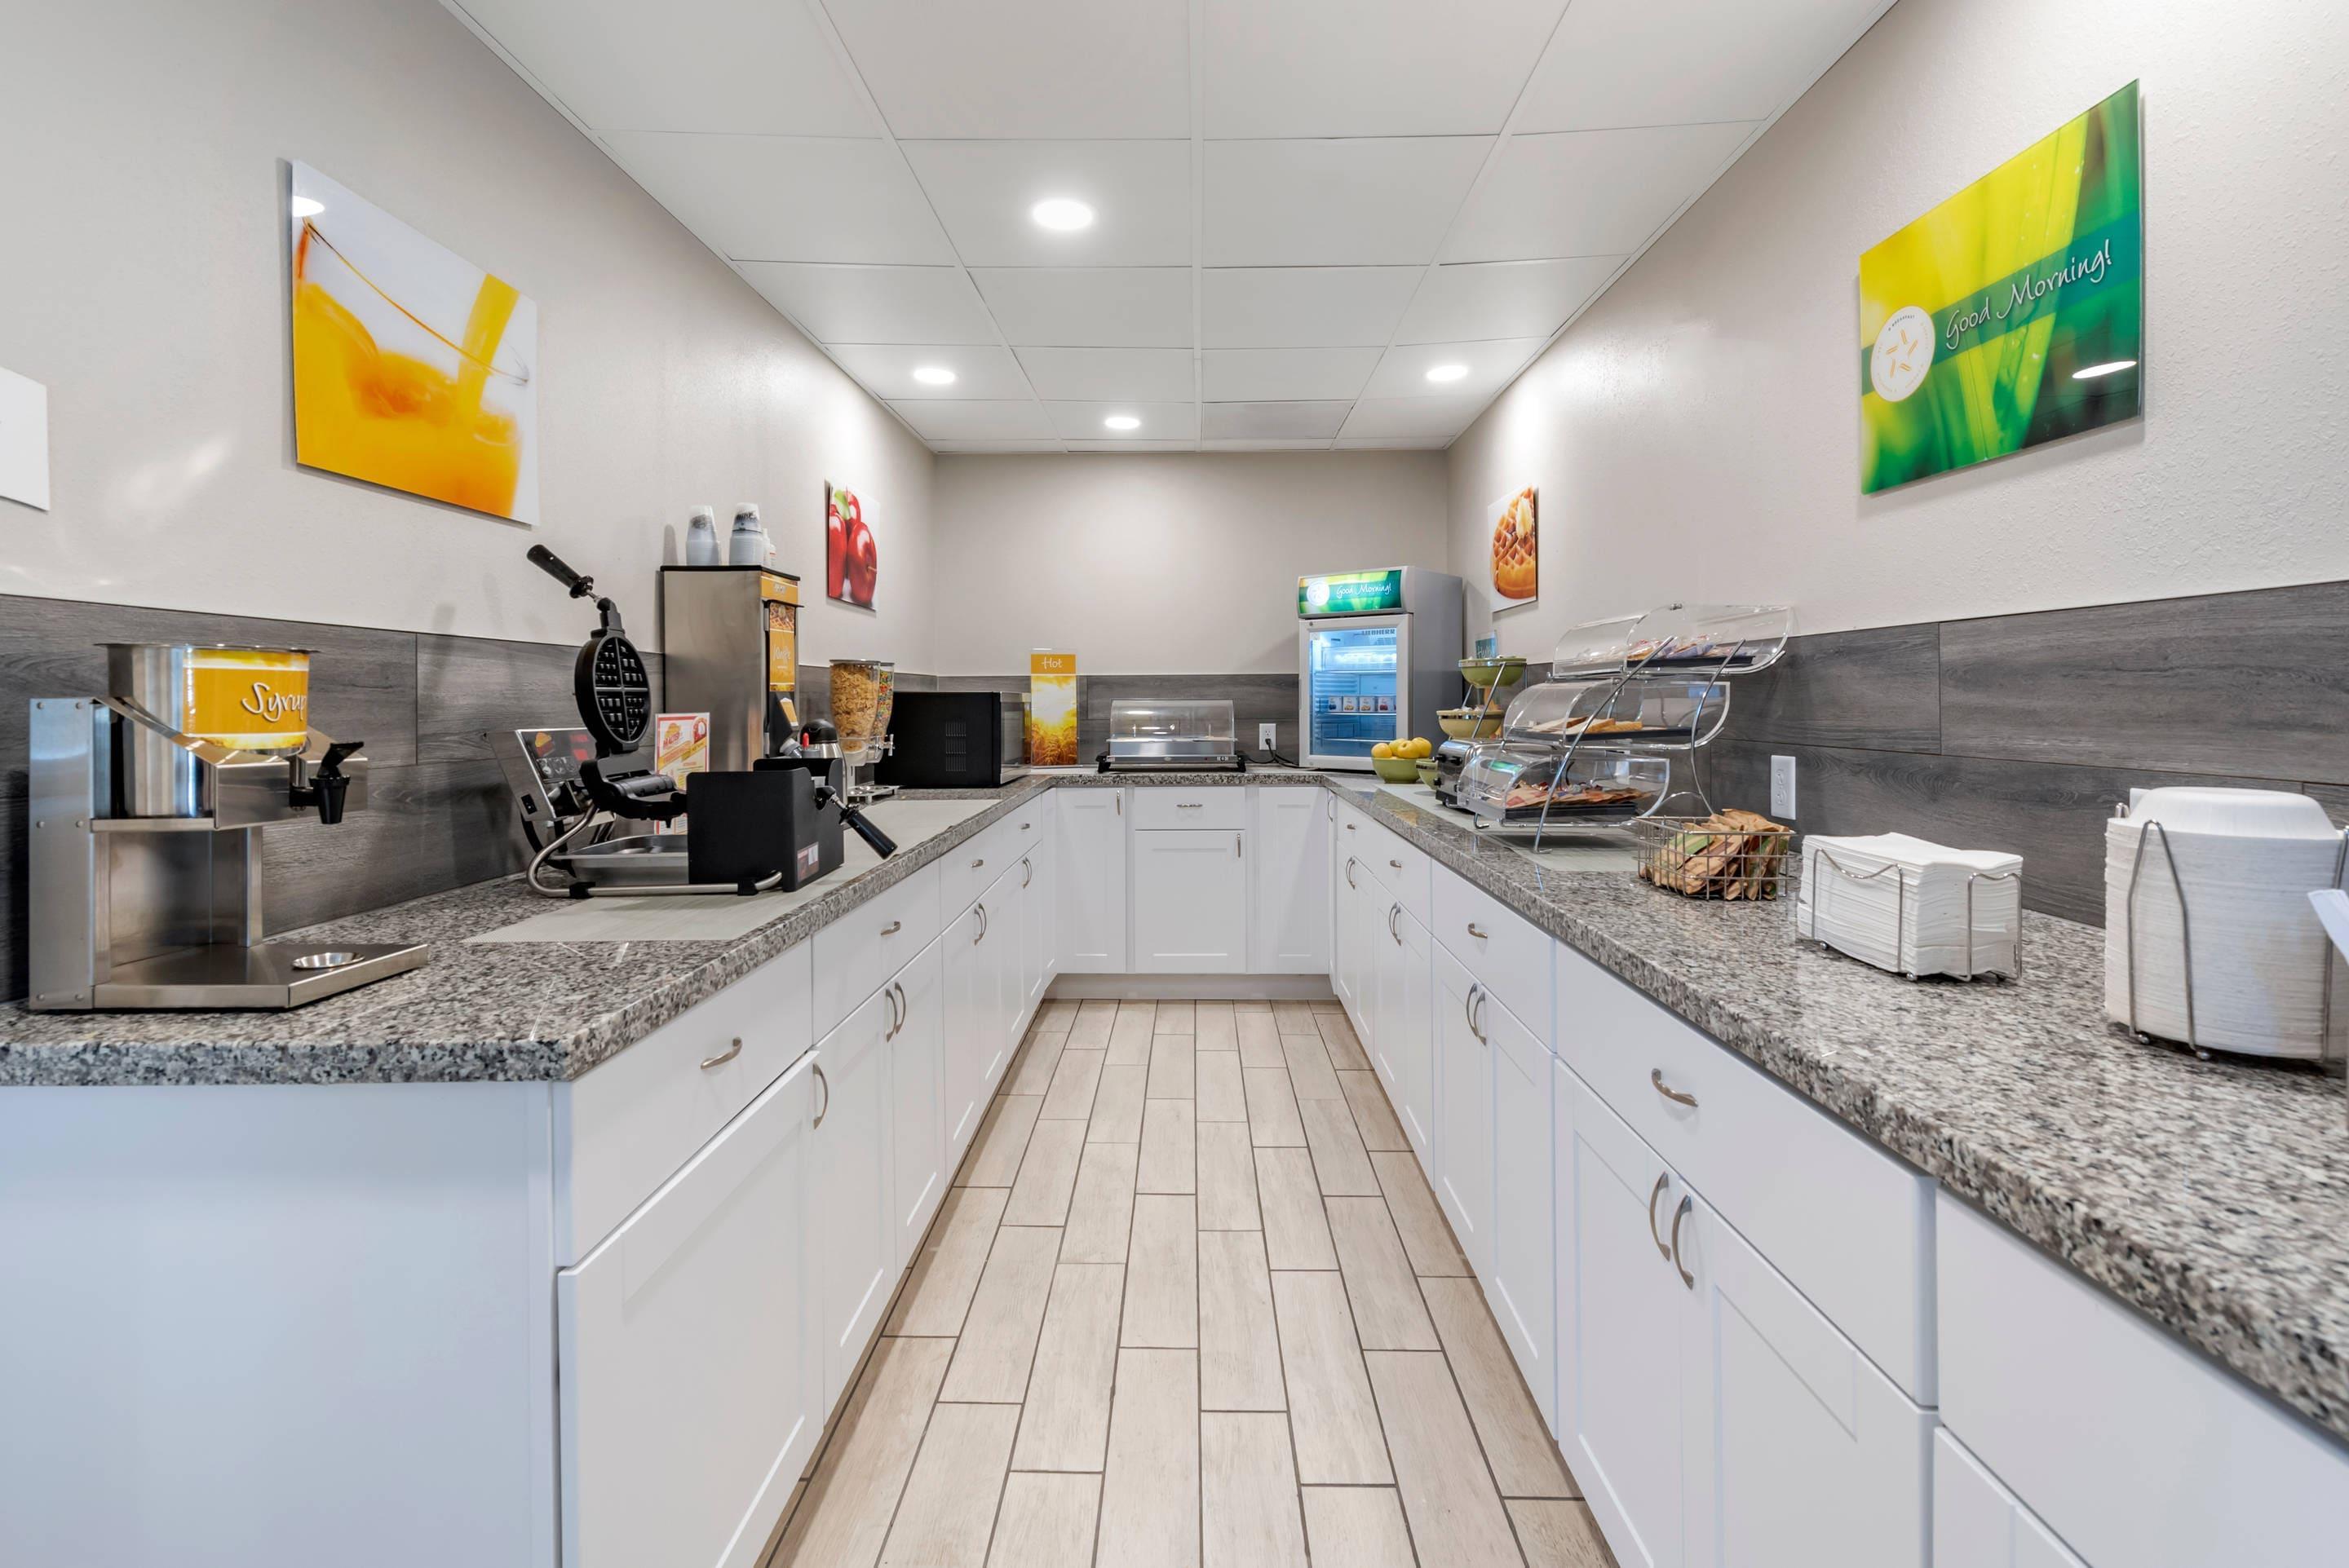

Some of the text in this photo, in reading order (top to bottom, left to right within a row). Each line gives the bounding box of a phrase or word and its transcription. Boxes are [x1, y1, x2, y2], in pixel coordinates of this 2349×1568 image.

[1946, 238, 2112, 350] Good Morning!
[1336, 582, 1391, 599] Good Morning!
[1040, 656, 1063, 669] Hot
